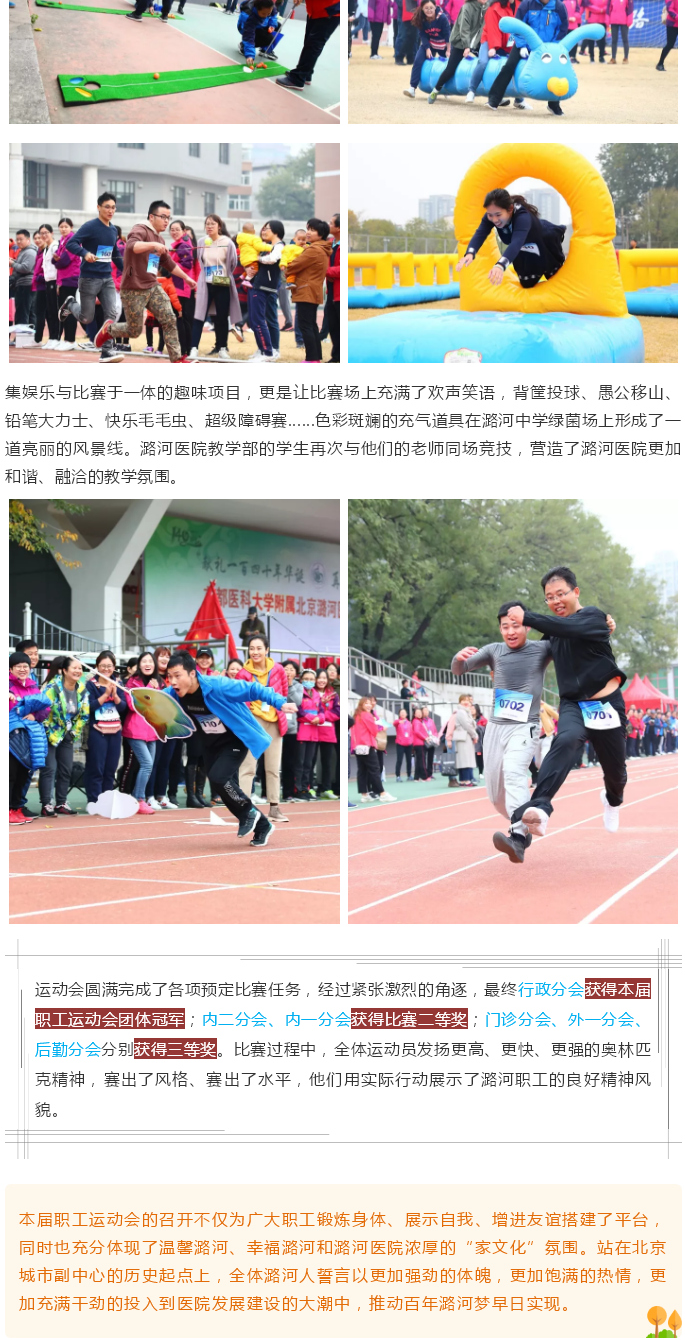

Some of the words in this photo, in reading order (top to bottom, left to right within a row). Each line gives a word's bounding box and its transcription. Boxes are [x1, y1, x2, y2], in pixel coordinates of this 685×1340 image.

[203, 584, 340, 619] 都医科大学附属北京潞河
[499, 698, 525, 712] 0702
